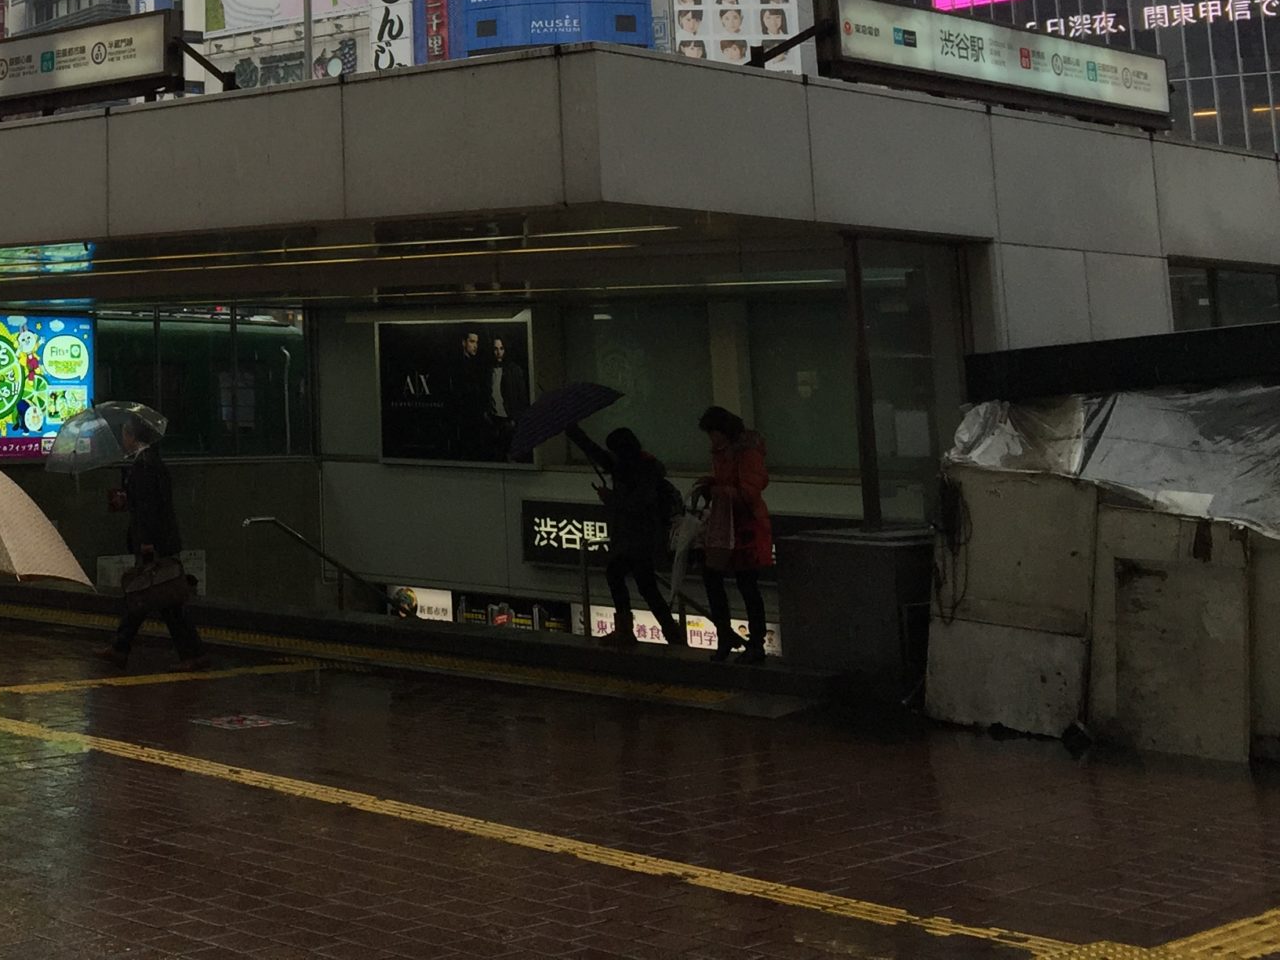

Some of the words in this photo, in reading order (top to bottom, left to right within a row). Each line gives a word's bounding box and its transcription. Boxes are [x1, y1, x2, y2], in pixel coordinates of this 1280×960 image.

[939, 28, 986, 64] 渋谷駅
[533, 517, 610, 553] 渋谷駅
